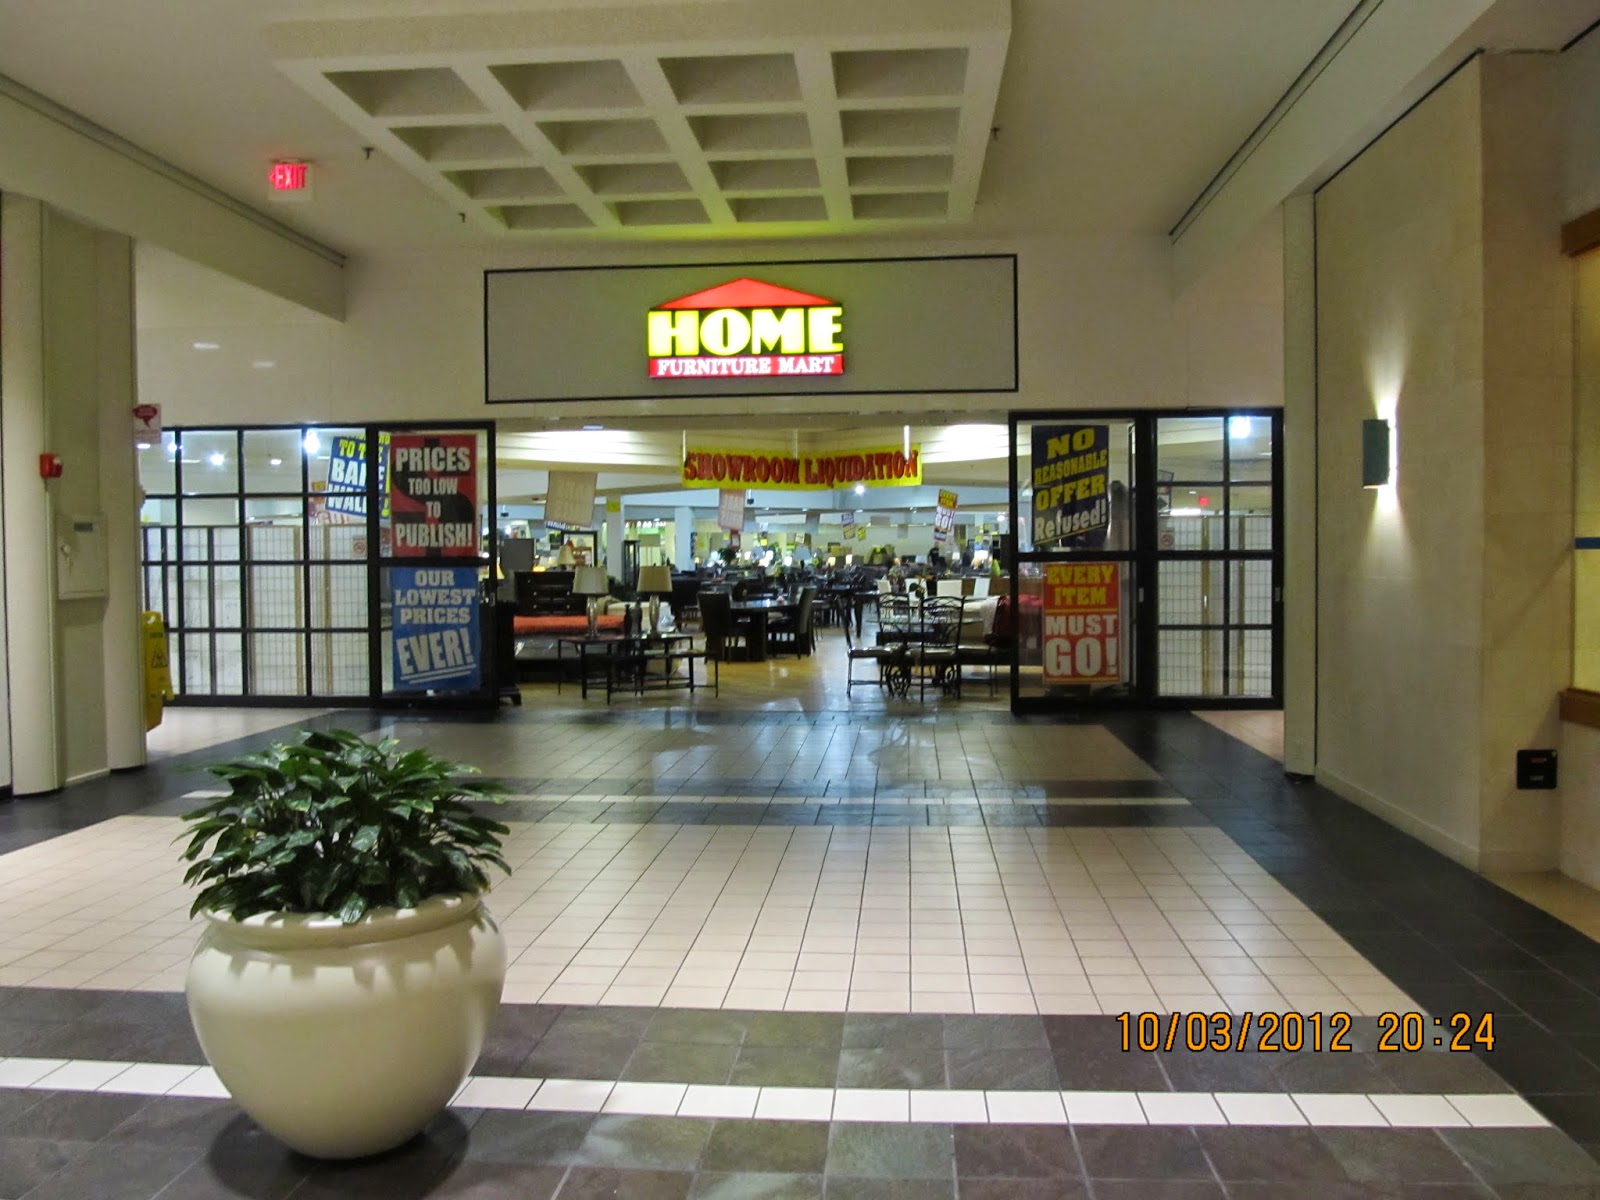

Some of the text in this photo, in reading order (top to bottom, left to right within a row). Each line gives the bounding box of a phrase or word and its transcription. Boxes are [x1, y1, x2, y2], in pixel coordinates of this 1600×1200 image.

[275, 164, 308, 190] EXIT
[648, 306, 844, 357] HOME
[657, 356, 835, 376] FURNITURE MART
[339, 439, 355, 459] TO
[1047, 428, 1094, 460] NO
[395, 447, 471, 472] PRICES
[684, 449, 919, 488] SHOWROOM LIQUIDATION
[1034, 449, 1108, 486] REASONABLE
[408, 477, 458, 496] TOO LOW
[1035, 474, 1105, 511] OFFER
[425, 501, 441, 518] TO
[1034, 498, 1107, 541] Refused!
[396, 523, 473, 547] PUBLISH!
[415, 570, 455, 586] OUR
[1046, 565, 1115, 585] EVERY
[395, 588, 476, 606] LOWEST
[1055, 587, 1107, 605] ITEM
[400, 607, 471, 624] PRICES
[1045, 614, 1117, 635] MUST
[396, 627, 474, 675] EVER!
[1045, 637, 1118, 676] GO!
